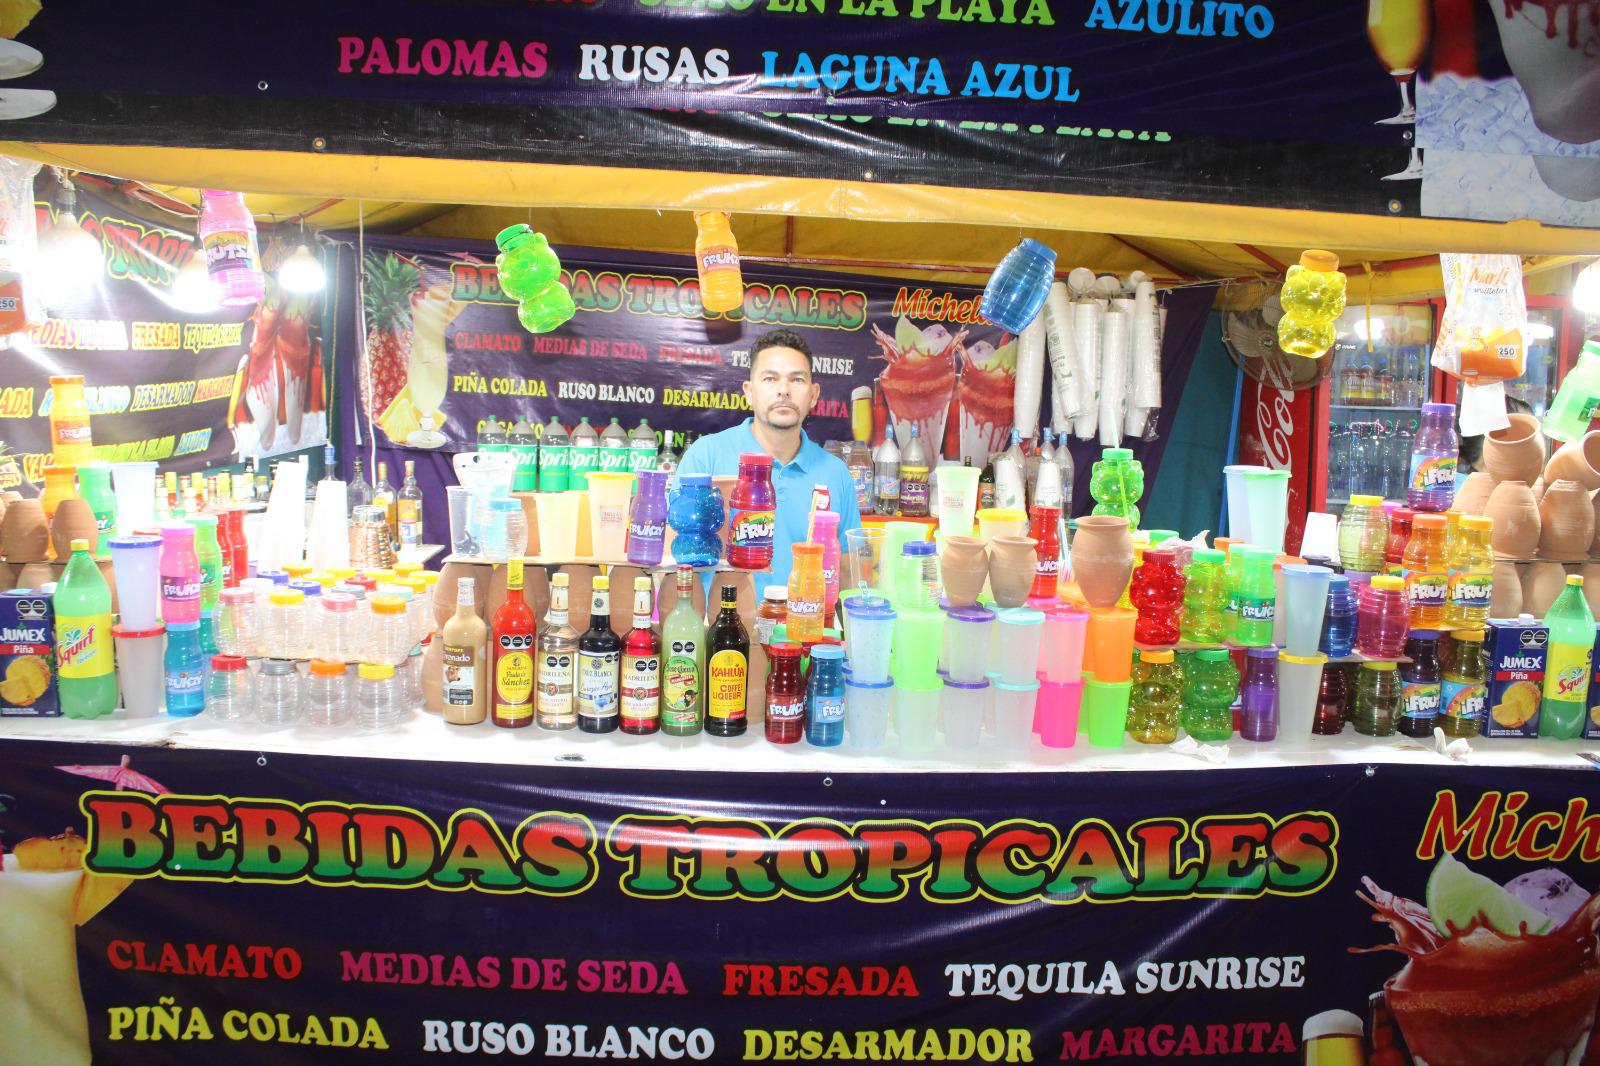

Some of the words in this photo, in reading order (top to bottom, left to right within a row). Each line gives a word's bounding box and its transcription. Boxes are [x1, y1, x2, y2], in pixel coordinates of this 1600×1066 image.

[1084, 0, 1274, 38] AZULITO
[337, 36, 548, 79] PALOMAS
[578, 43, 730, 84] RUSAS
[762, 51, 951, 95] LAGUNA
[960, 60, 1080, 103] AZUL
[625, 274, 866, 330] TROCALES
[892, 286, 989, 326] Michel
[454, 332, 522, 352] CLAMATO
[533, 336, 587, 356] MEDIAS
[590, 338, 609, 358] DE
[612, 341, 648, 361] SEDA
[657, 344, 724, 367] FRESADA
[1500, 346, 1515, 356] 250
[811, 356, 854, 376] NRISE
[131, 380, 196, 411] DESARMADOR
[453, 371, 488, 394] PIÑA
[490, 377, 548, 398] COLADA
[558, 381, 596, 401] RUSO
[598, 385, 655, 405] BLANCO
[0, 627, 46, 642] JUMEX
[13, 644, 34, 653] Piña
[57, 624, 96, 668] Squirt
[712, 664, 745, 678] KAHLÚA
[1500, 655, 1542, 669] JUMEX
[1510, 671, 1528, 680] Piña
[712, 691, 742, 701] LIQUEUR
[81, 789, 597, 896] BEBIDAS
[609, 812, 1336, 900] TROPICALES
[108, 940, 302, 979] CLAMATO
[340, 951, 501, 989] MEDIAS
[512, 954, 568, 993] DE
[576, 956, 689, 995] SEDA
[722, 964, 919, 998] FRESADA
[945, 962, 1126, 1000] TEQUILA
[1135, 955, 1306, 997] SUNRISE
[108, 997, 213, 1042] PIÑA
[222, 1010, 389, 1050] COLADA
[422, 1019, 534, 1056] RUSO
[544, 1024, 715, 1060] BLANCO
[1060, 1021, 1298, 1060] MARGARITA
[743, 1028, 1034, 1064] DESARMADOR
